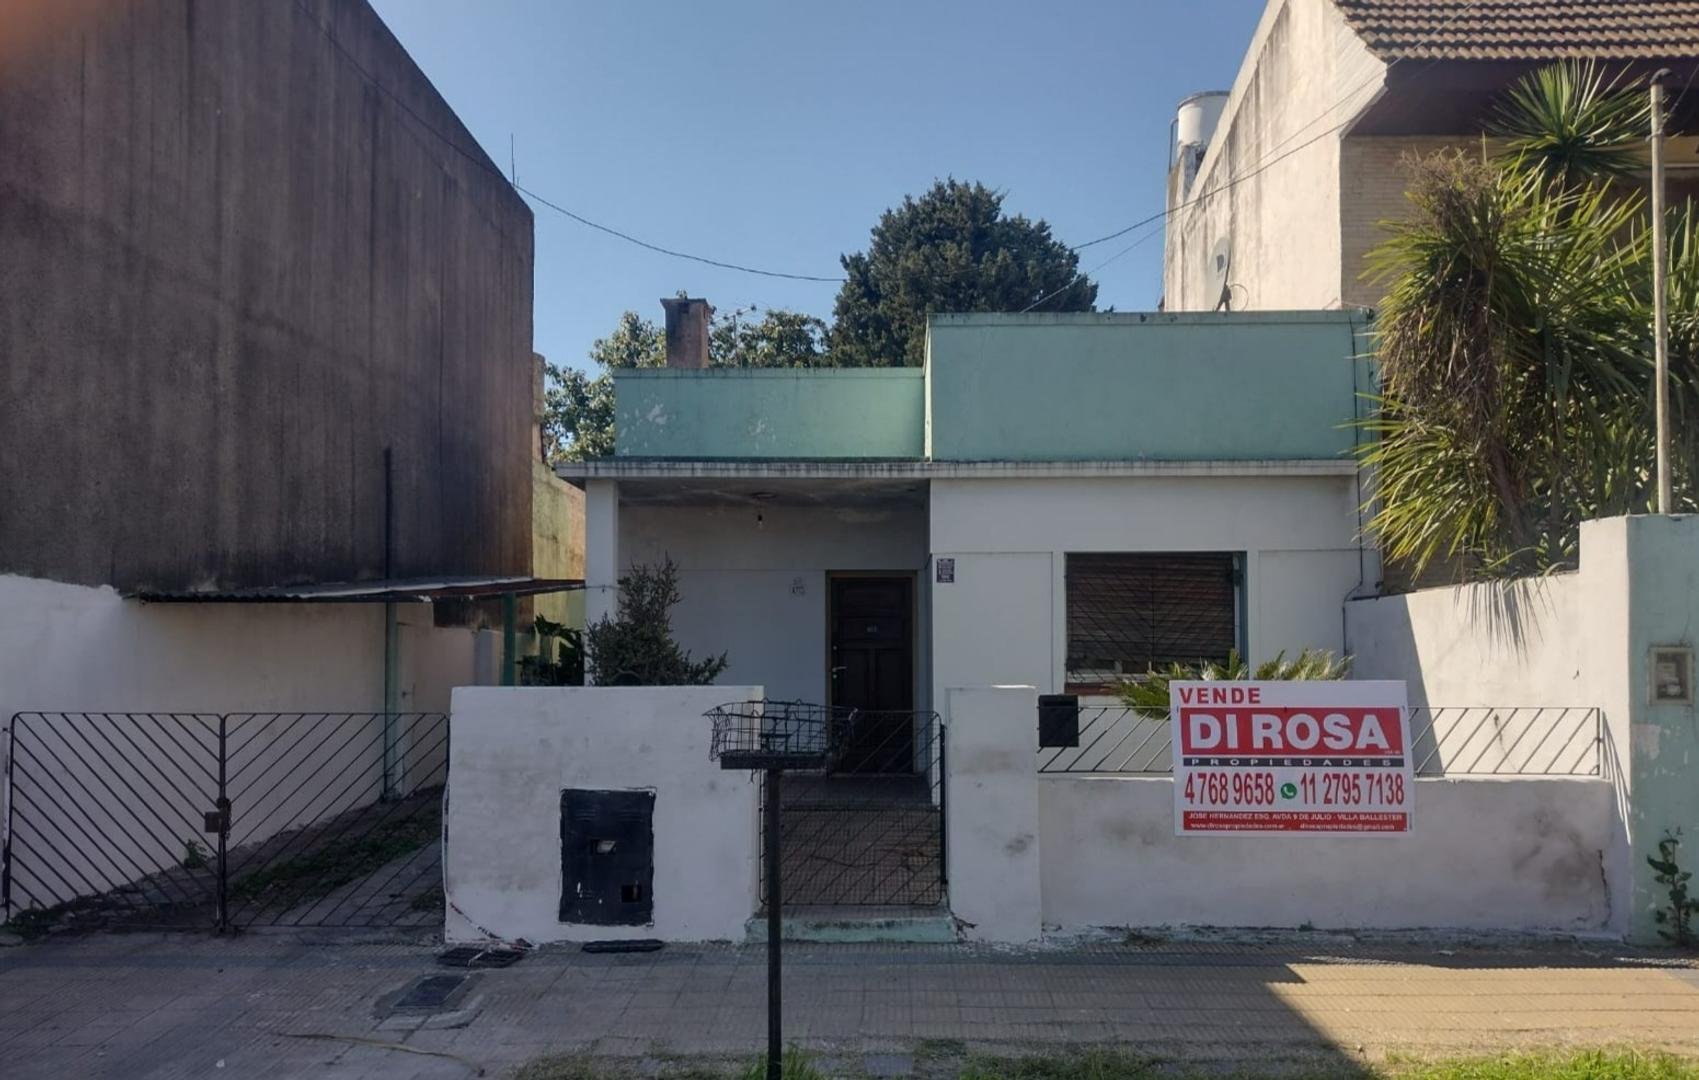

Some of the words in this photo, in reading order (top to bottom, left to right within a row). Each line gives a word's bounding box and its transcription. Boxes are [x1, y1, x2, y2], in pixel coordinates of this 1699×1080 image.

[1179, 687, 1261, 704] VENDE
[1189, 714, 1239, 749] DI
[1251, 713, 1390, 750] ROSA
[1191, 759, 1391, 767] PROPIEDADES
[1184, 772, 1228, 805] 4768
[1233, 772, 1275, 805] 9658
[1300, 773, 1317, 805] 11
[1323, 773, 1361, 805] 2795
[1365, 773, 1404, 805] 7138
[1209, 812, 1253, 820] HERNANDEZ
[1299, 812, 1309, 820] DE
[1310, 812, 1332, 820] JULIO
[1359, 813, 1402, 821] BALLESTER
